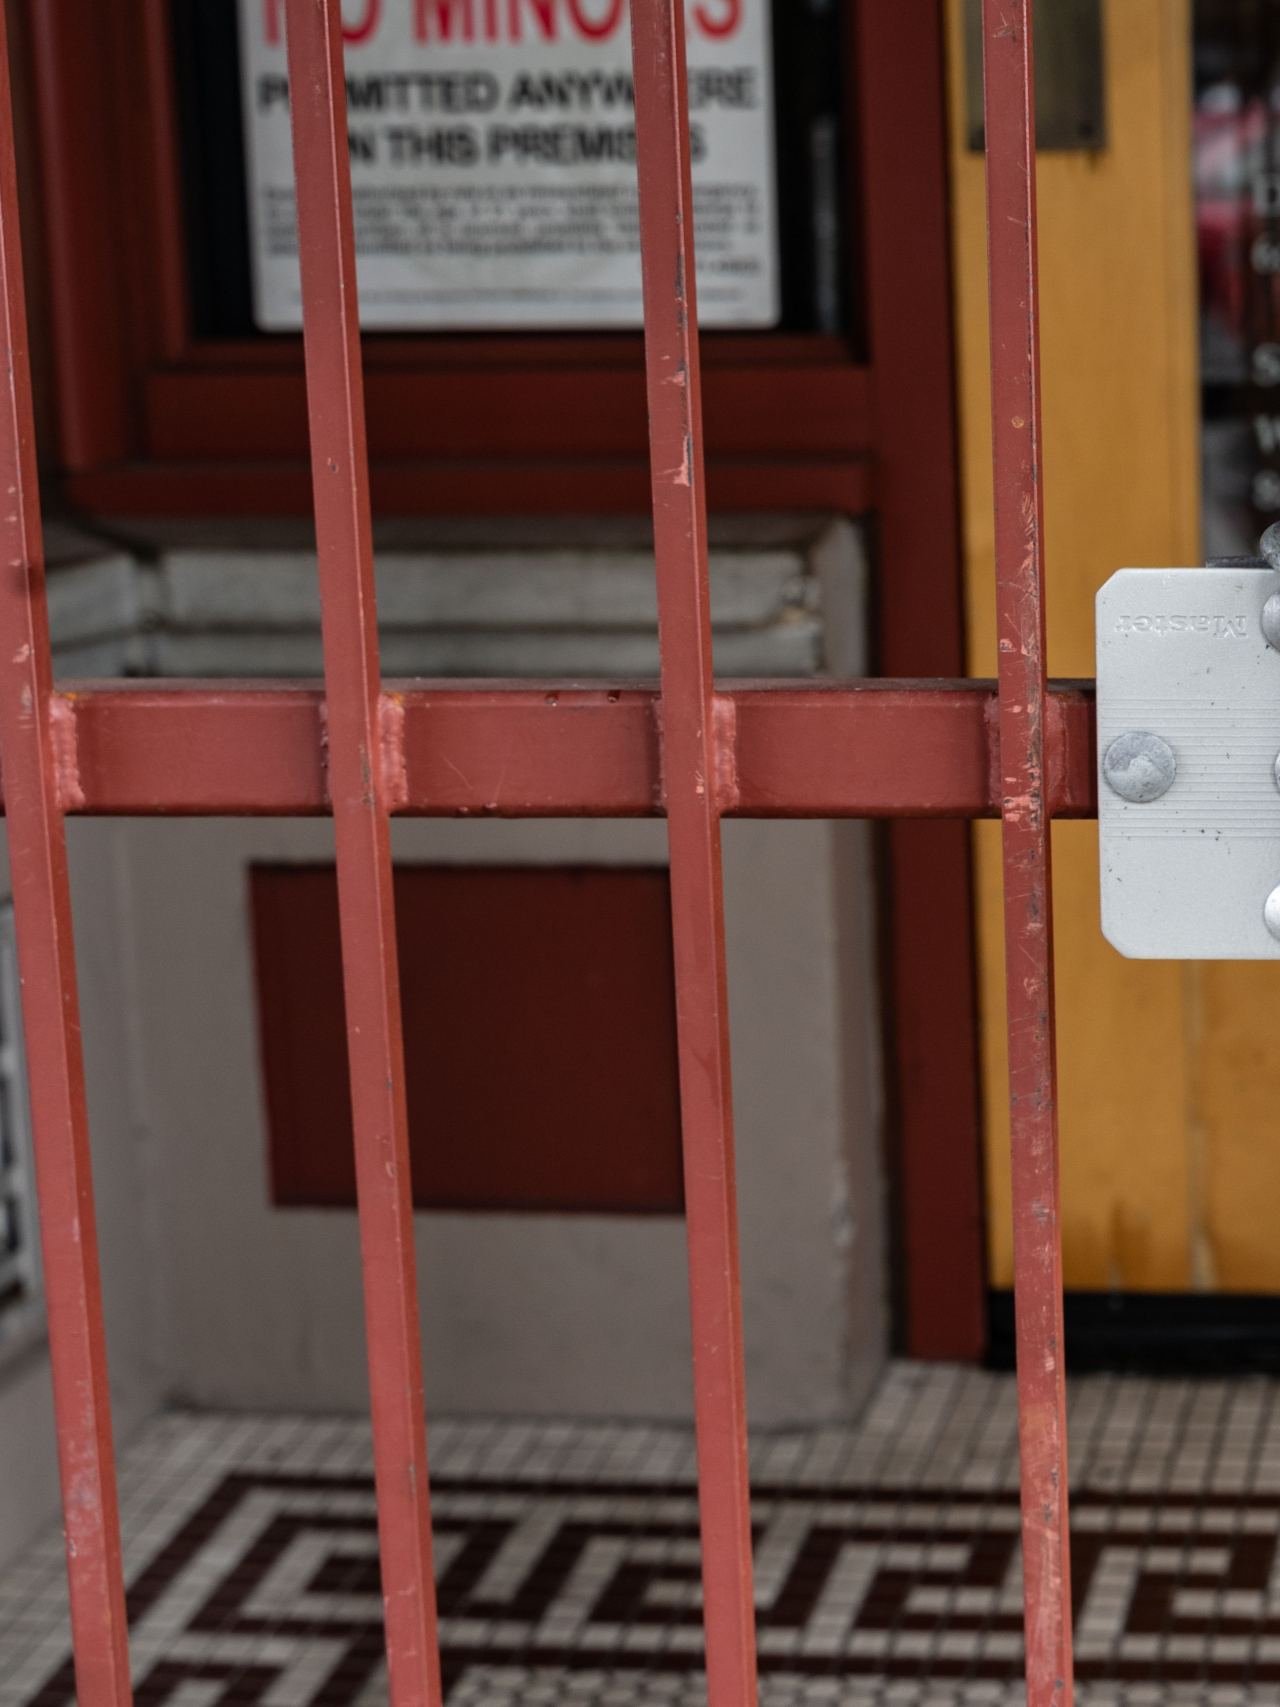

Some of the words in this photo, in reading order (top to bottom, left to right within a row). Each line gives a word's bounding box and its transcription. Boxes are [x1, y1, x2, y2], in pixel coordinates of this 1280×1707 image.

[412, 0, 744, 44] MINOS
[256, 70, 499, 114] PMITTED
[384, 124, 481, 165] THIS
[1115, 614, 1249, 640] Master
